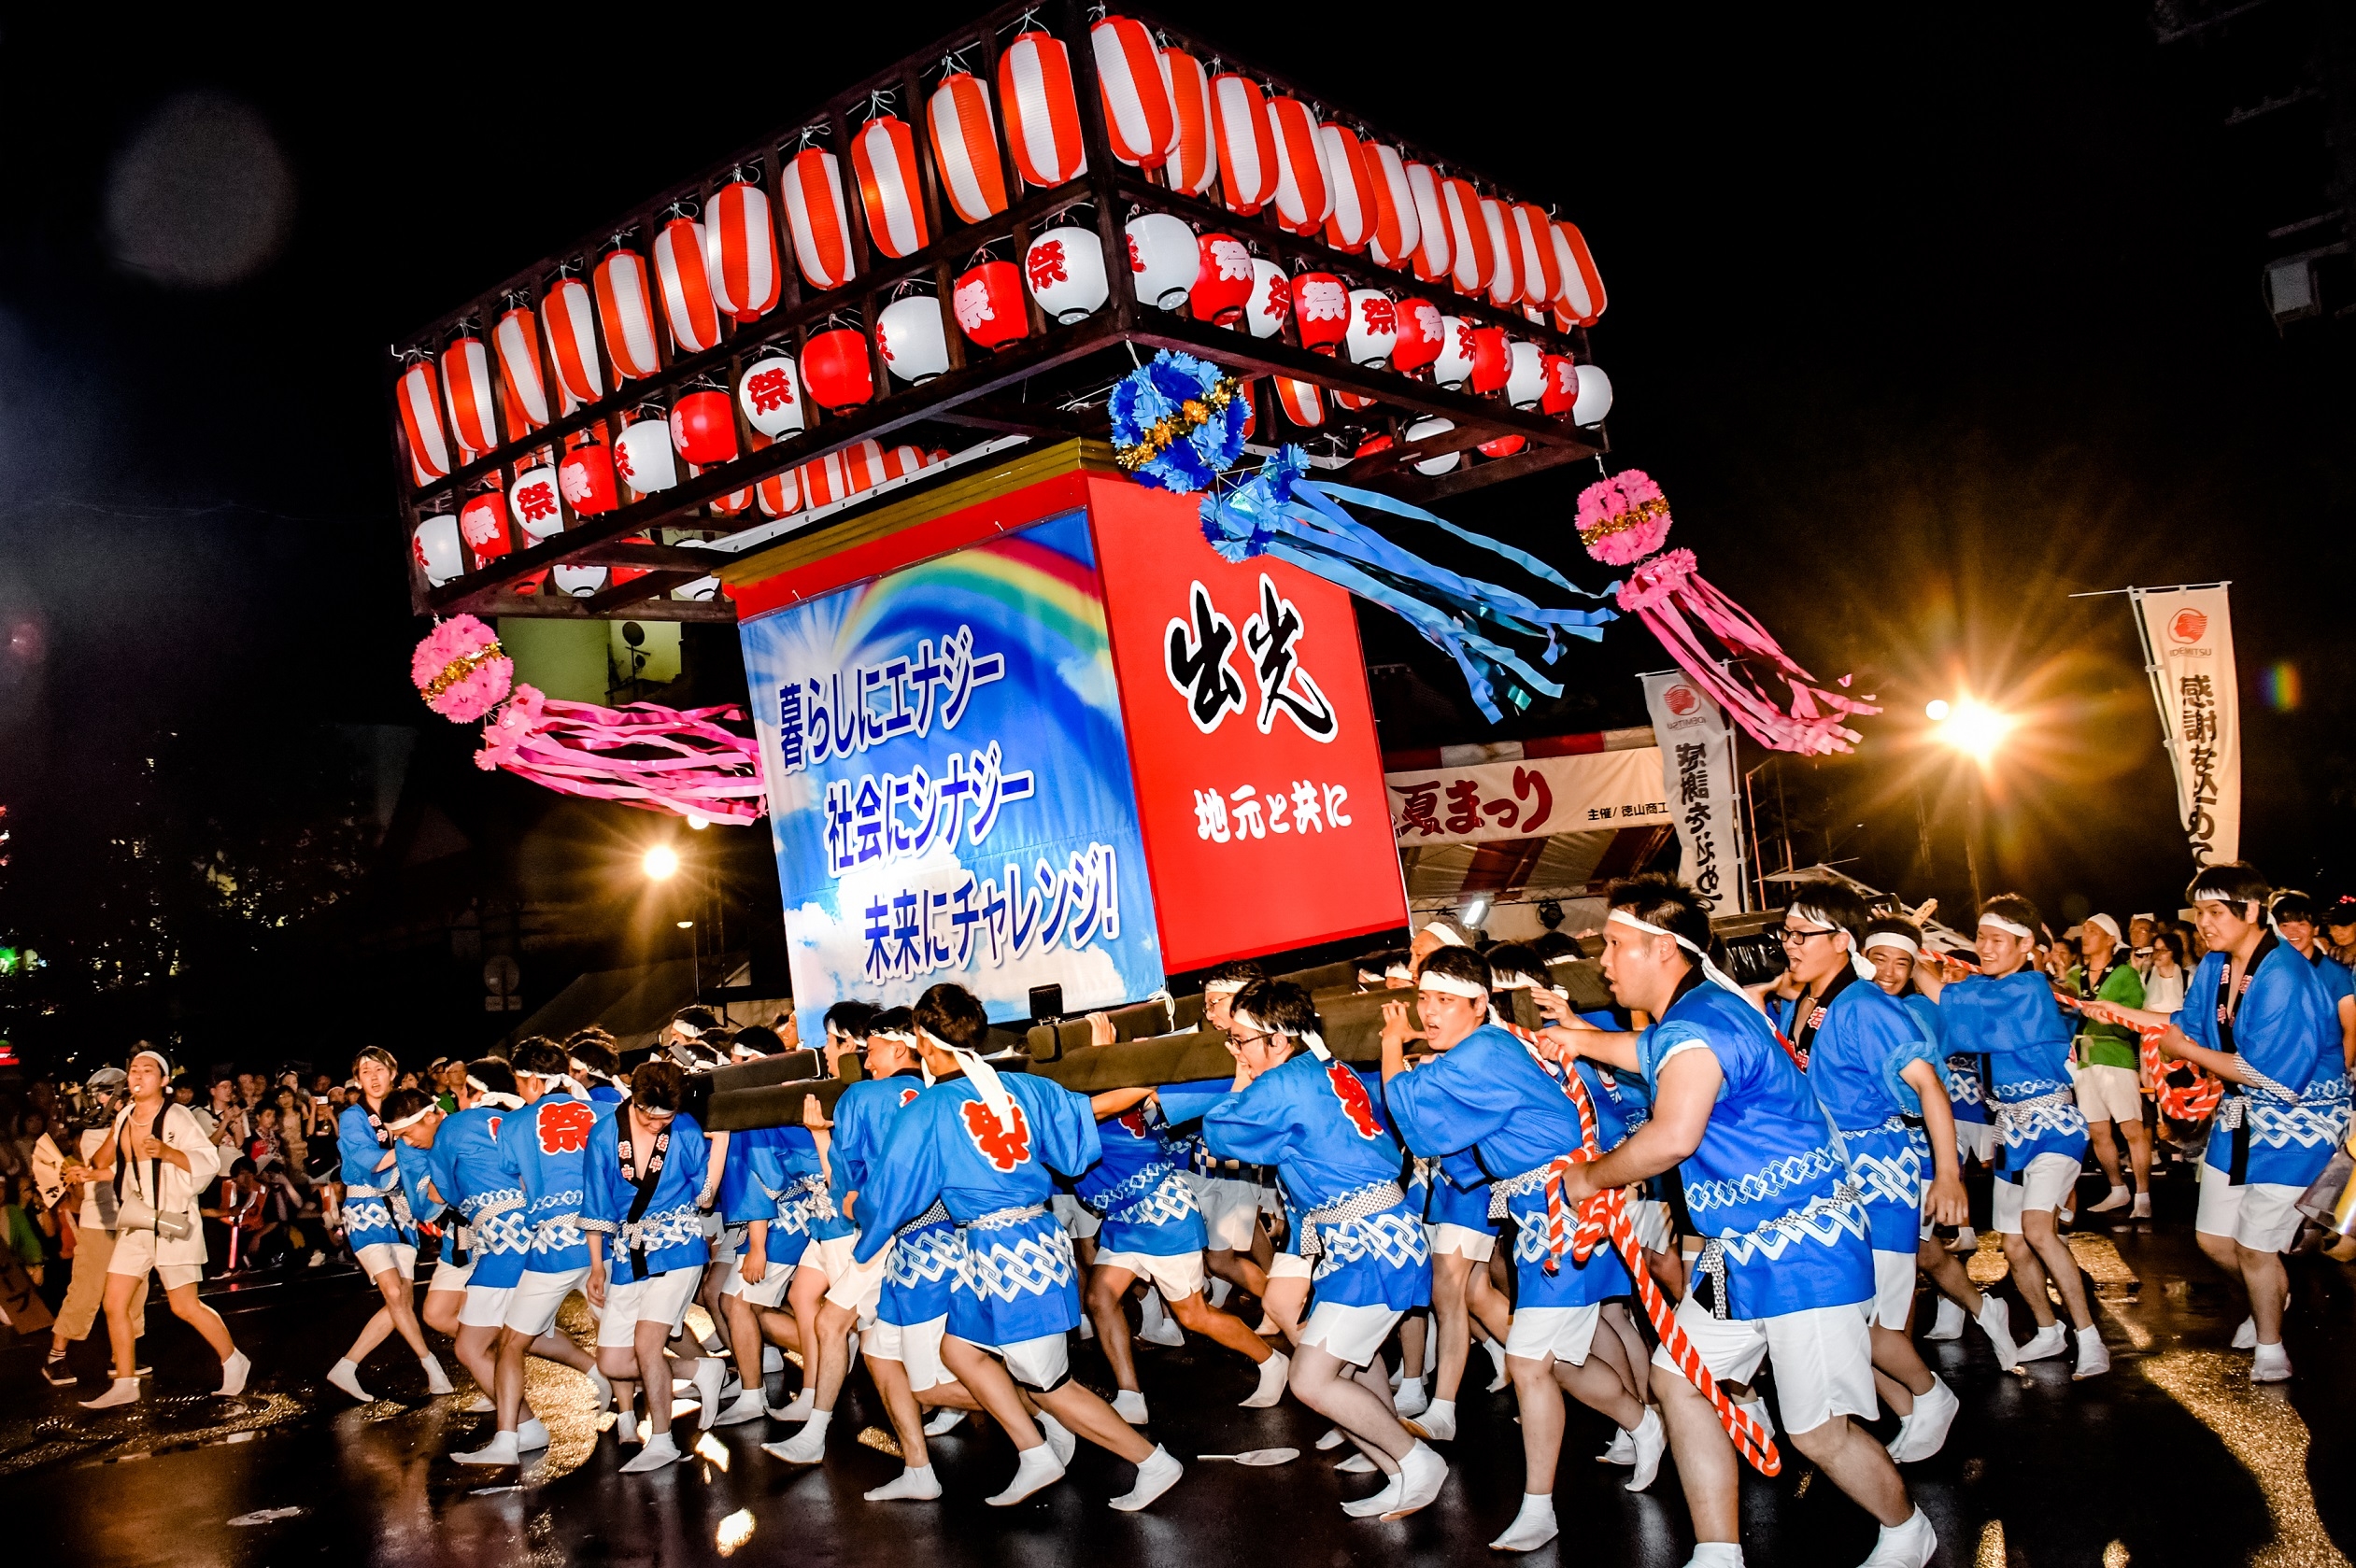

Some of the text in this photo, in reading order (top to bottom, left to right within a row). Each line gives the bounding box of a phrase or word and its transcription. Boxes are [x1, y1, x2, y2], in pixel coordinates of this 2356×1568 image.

[1028, 239, 1069, 293] 祭
[1211, 240, 1254, 281] 祭
[1302, 281, 1346, 322] 祭
[1361, 298, 1398, 336] 祭
[746, 368, 795, 416] 祭
[517, 481, 559, 524] 祭
[1164, 572, 1338, 743] 出光
[2169, 646, 2212, 657] IDEMITSU
[777, 625, 1005, 775] 暮らしにエナジー
[824, 741, 1035, 879] 社会にシナジー
[1194, 779, 1353, 844] 地元と共に
[1390, 766, 1553, 837] 夏まつり
[1326, 1060, 1384, 1141] 祭
[536, 1101, 598, 1156] 祭
[649, 1133, 670, 1173] 若中
